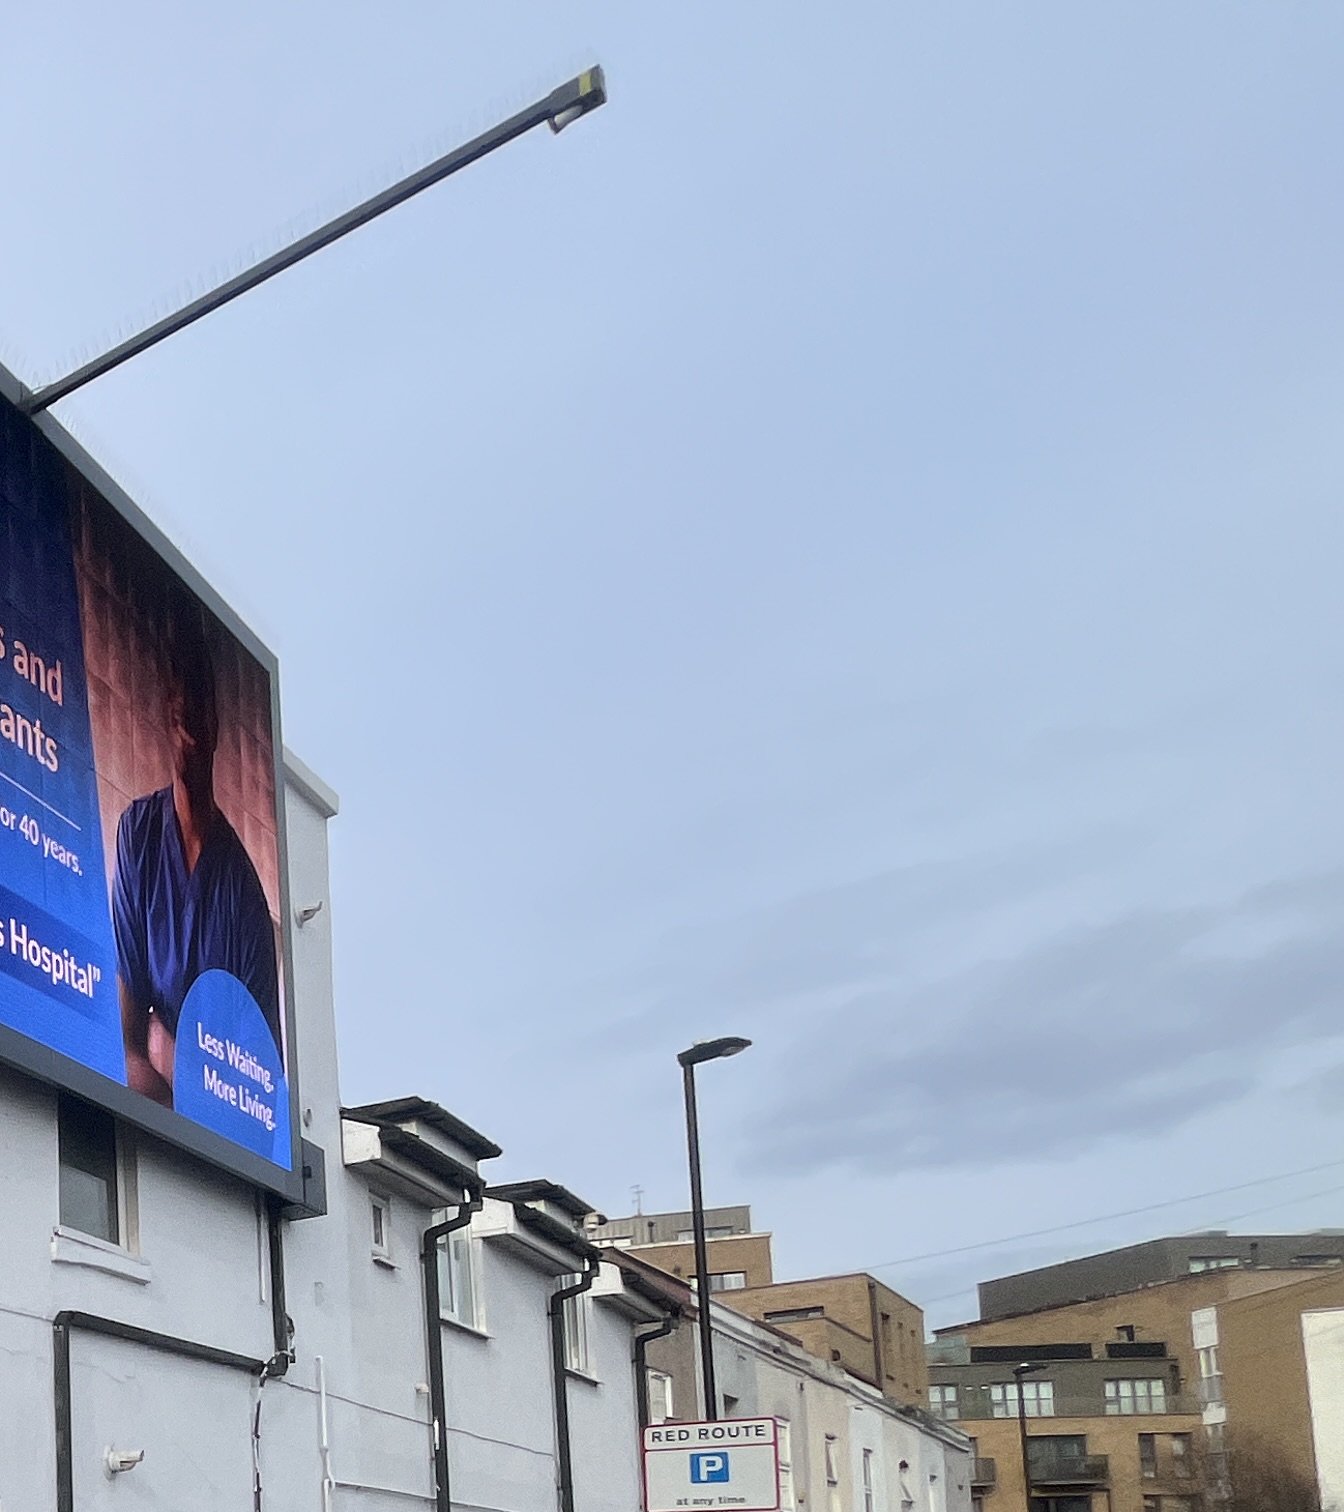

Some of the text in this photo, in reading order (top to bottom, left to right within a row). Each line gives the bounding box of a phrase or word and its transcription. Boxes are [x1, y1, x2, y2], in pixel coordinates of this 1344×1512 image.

[13, 640, 63, 707] and
[18, 813, 40, 847] 40
[42, 833, 84, 877] years.
[197, 1021, 274, 1094] Less Waiting.
[204, 1063, 277, 1131] More Living.
[651, 1424, 766, 1443] RED ROUTE
[698, 1455, 724, 1482] P
[676, 1496, 746, 1507] at any time
